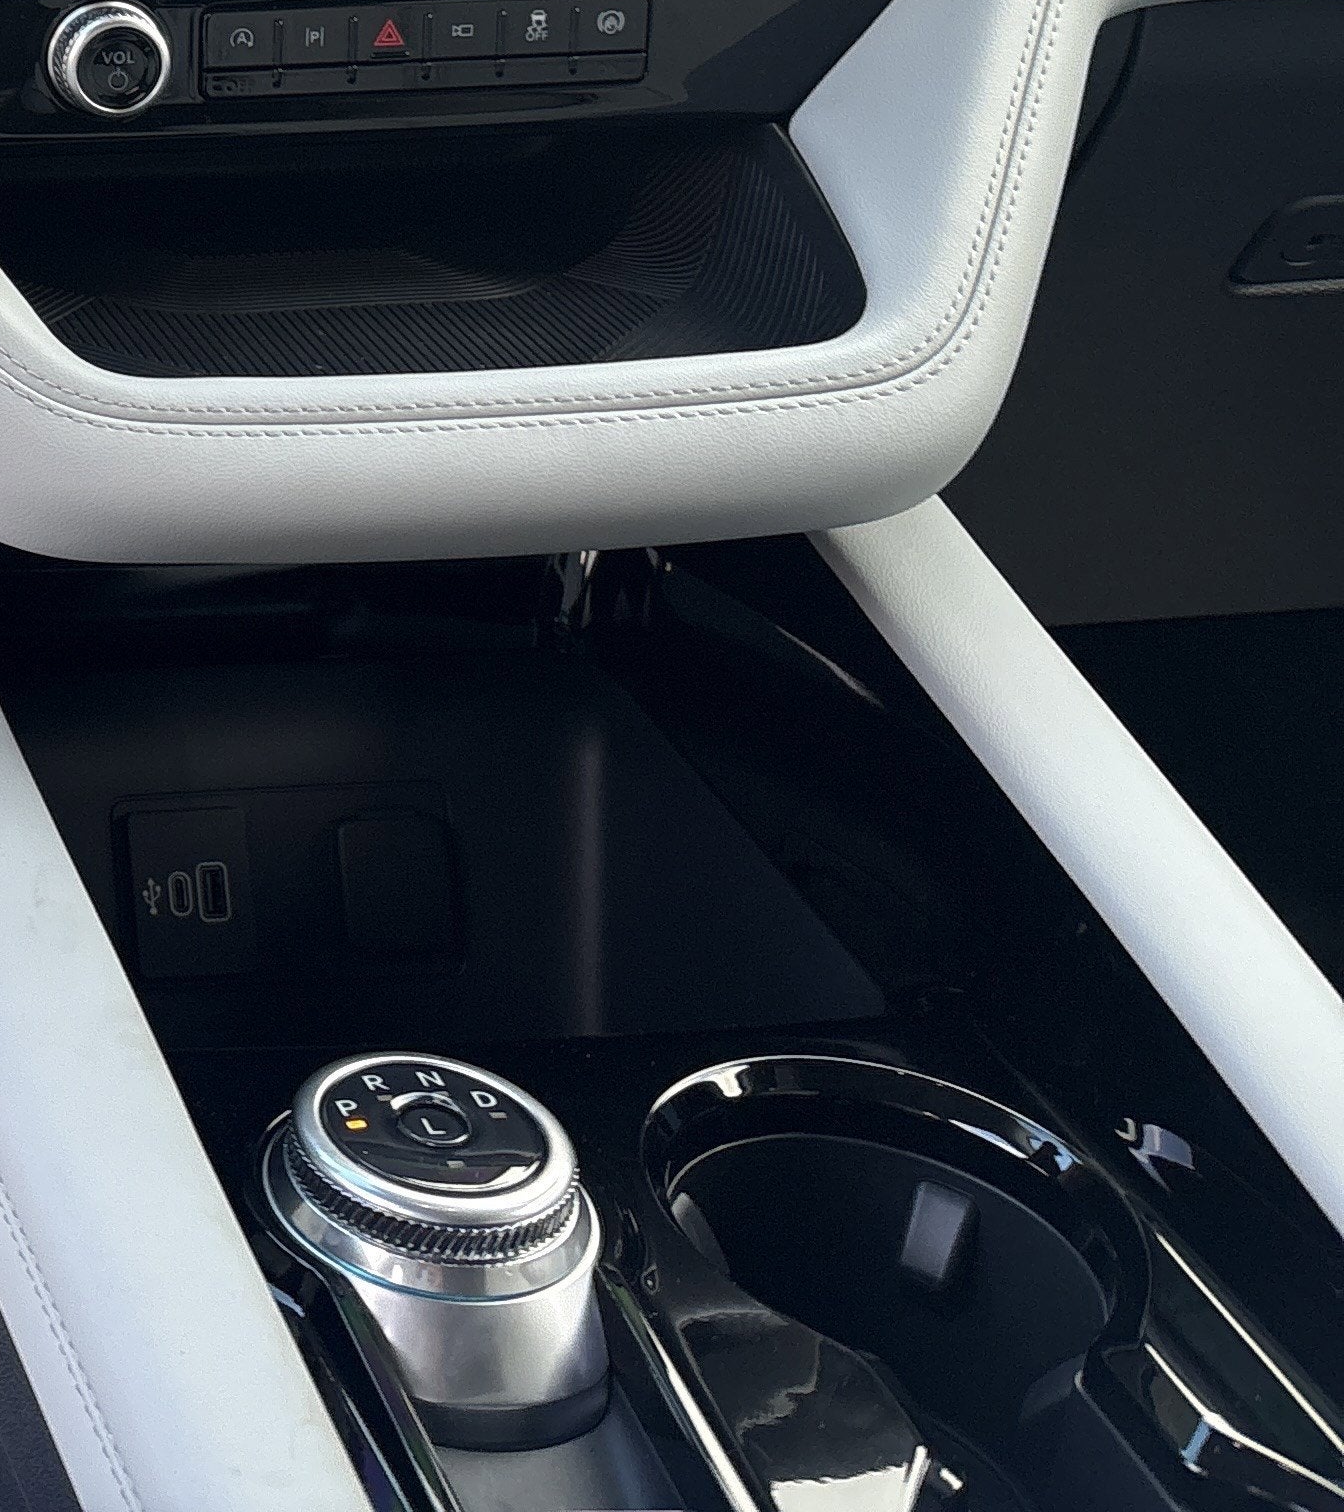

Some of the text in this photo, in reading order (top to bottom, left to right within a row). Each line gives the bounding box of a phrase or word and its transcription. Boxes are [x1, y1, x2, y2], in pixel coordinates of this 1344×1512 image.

[524, 30, 548, 42] OFF
[101, 49, 136, 66] VOL
[334, 1071, 497, 1117] P R N D
[421, 1118, 446, 1135] L
